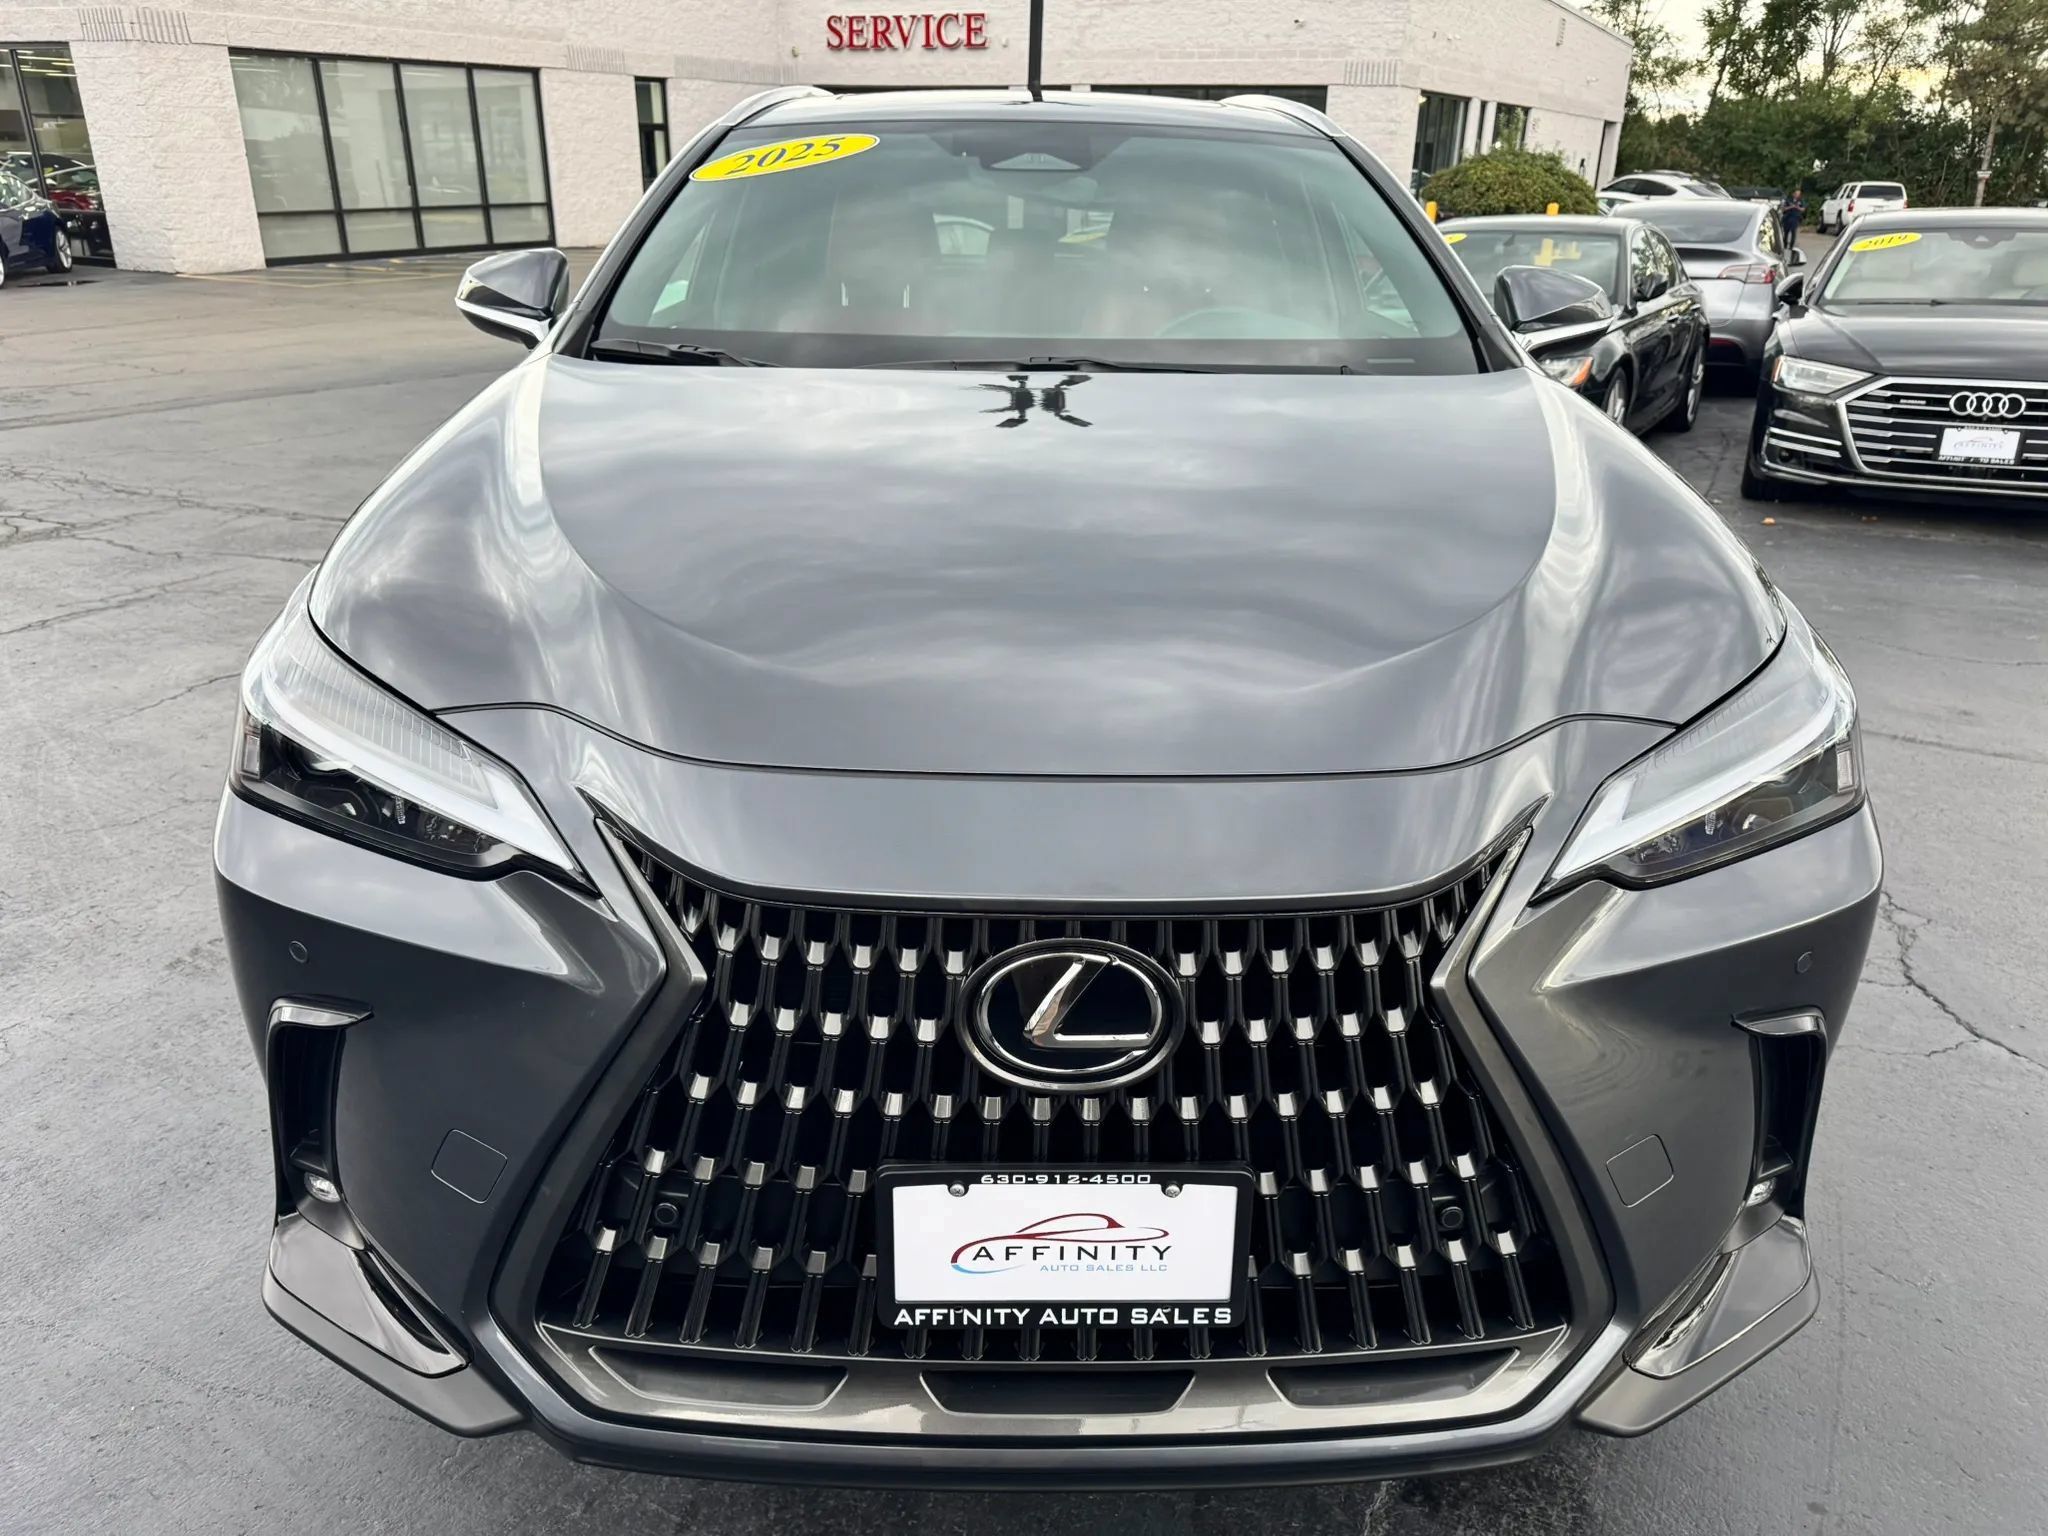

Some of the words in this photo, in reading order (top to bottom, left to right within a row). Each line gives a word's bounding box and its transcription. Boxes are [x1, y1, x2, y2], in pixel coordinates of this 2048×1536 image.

[826, 12, 988, 50] SERVICE
[724, 136, 847, 176] 2025
[980, 1174, 1152, 1185] 630-912-4500
[972, 1245, 1173, 1262] AFFINITY
[1039, 1264, 1080, 1273] AUTO
[1085, 1264, 1135, 1273] SALES
[1140, 1264, 1169, 1273] LLC
[893, 1307, 1031, 1326] AFFINITY
[1038, 1307, 1119, 1325] AUTO
[1130, 1307, 1232, 1325] SALES
